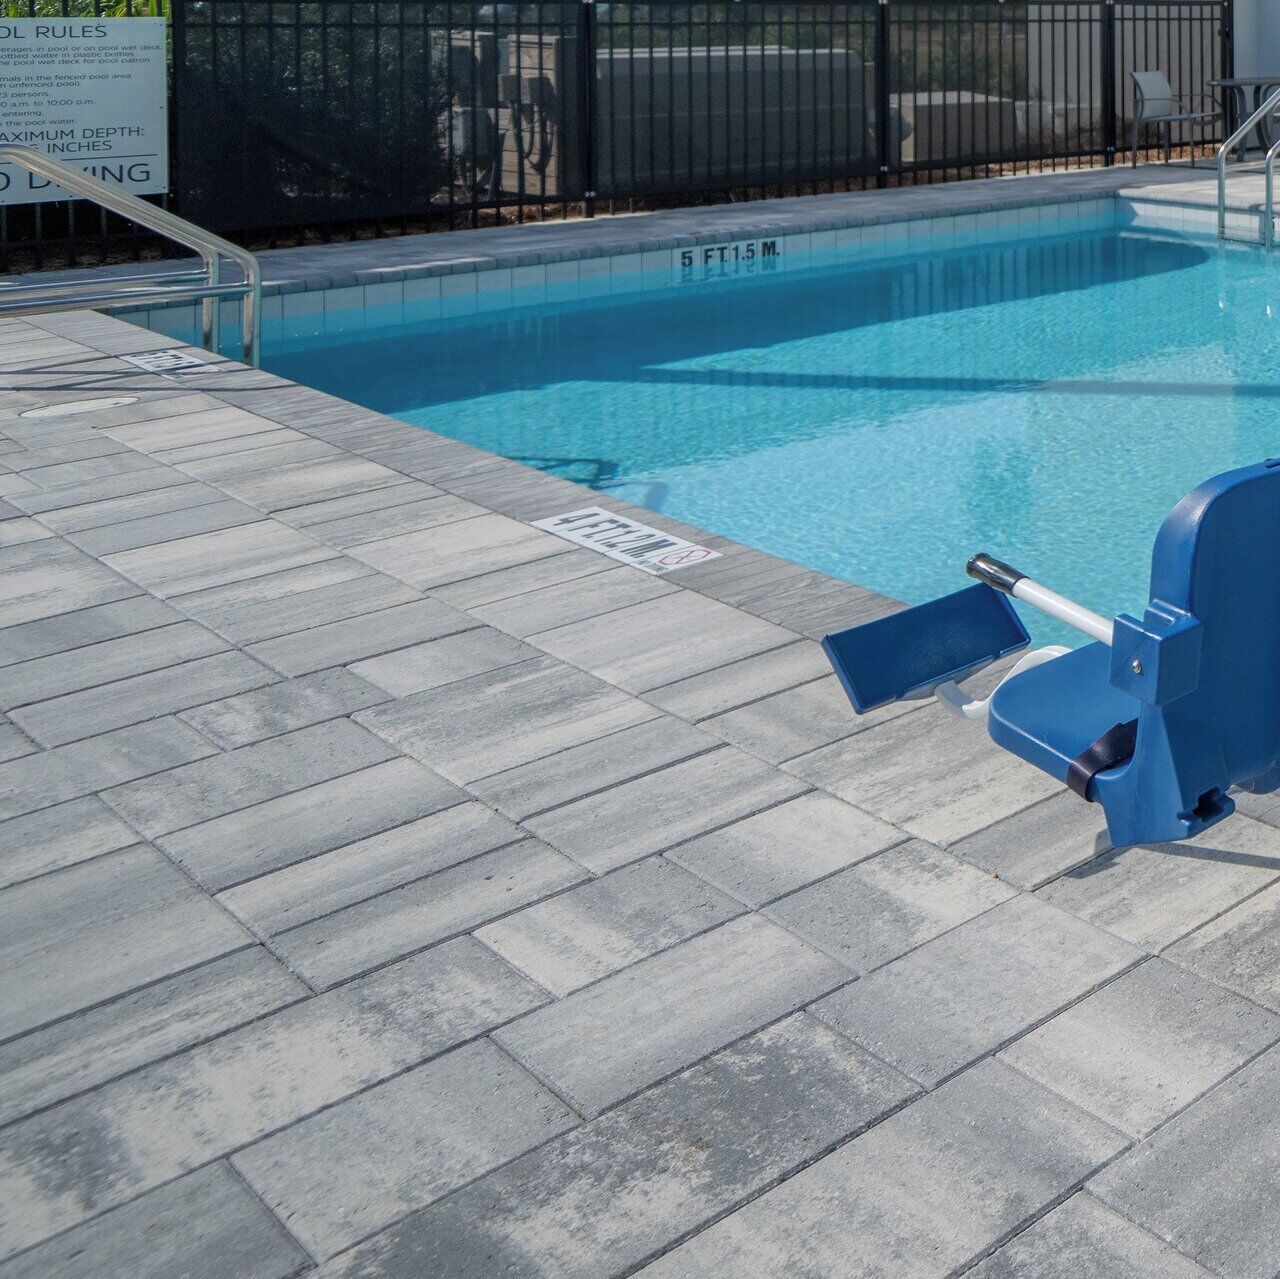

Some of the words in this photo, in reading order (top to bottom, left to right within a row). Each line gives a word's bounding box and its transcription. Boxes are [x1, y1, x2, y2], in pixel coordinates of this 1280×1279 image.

[36, 25, 107, 39] RULES
[0, 129, 74, 143] AXIMUM
[82, 126, 145, 139] DEPTH:
[47, 140, 112, 153] INCHES
[681, 250, 693, 268] 5
[732, 243, 755, 260] 1.5
